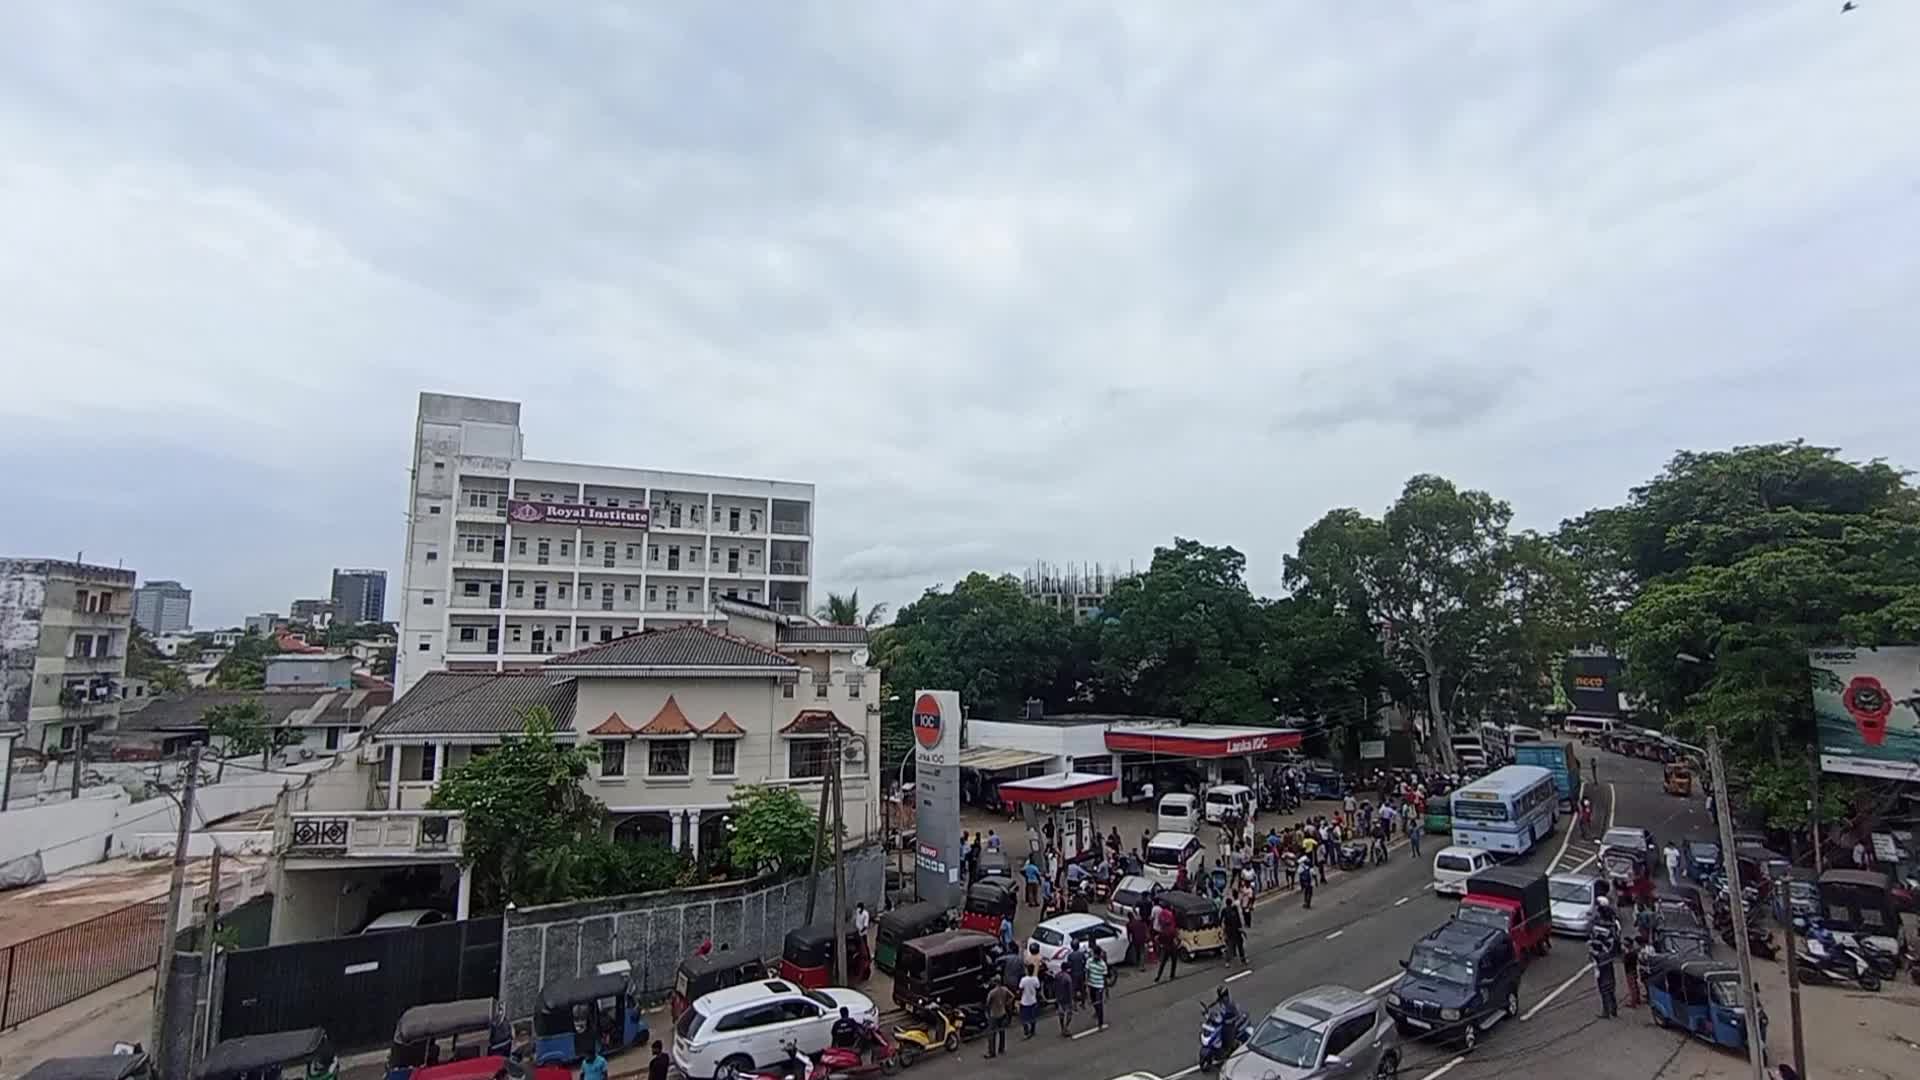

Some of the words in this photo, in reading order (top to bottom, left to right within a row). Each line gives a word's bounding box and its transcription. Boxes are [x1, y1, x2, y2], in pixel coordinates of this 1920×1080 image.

[547, 506, 586, 518] Royal
[589, 508, 648, 522] Institute
[920, 715, 934, 728] IOC
[1253, 737, 1268, 750] IOC
